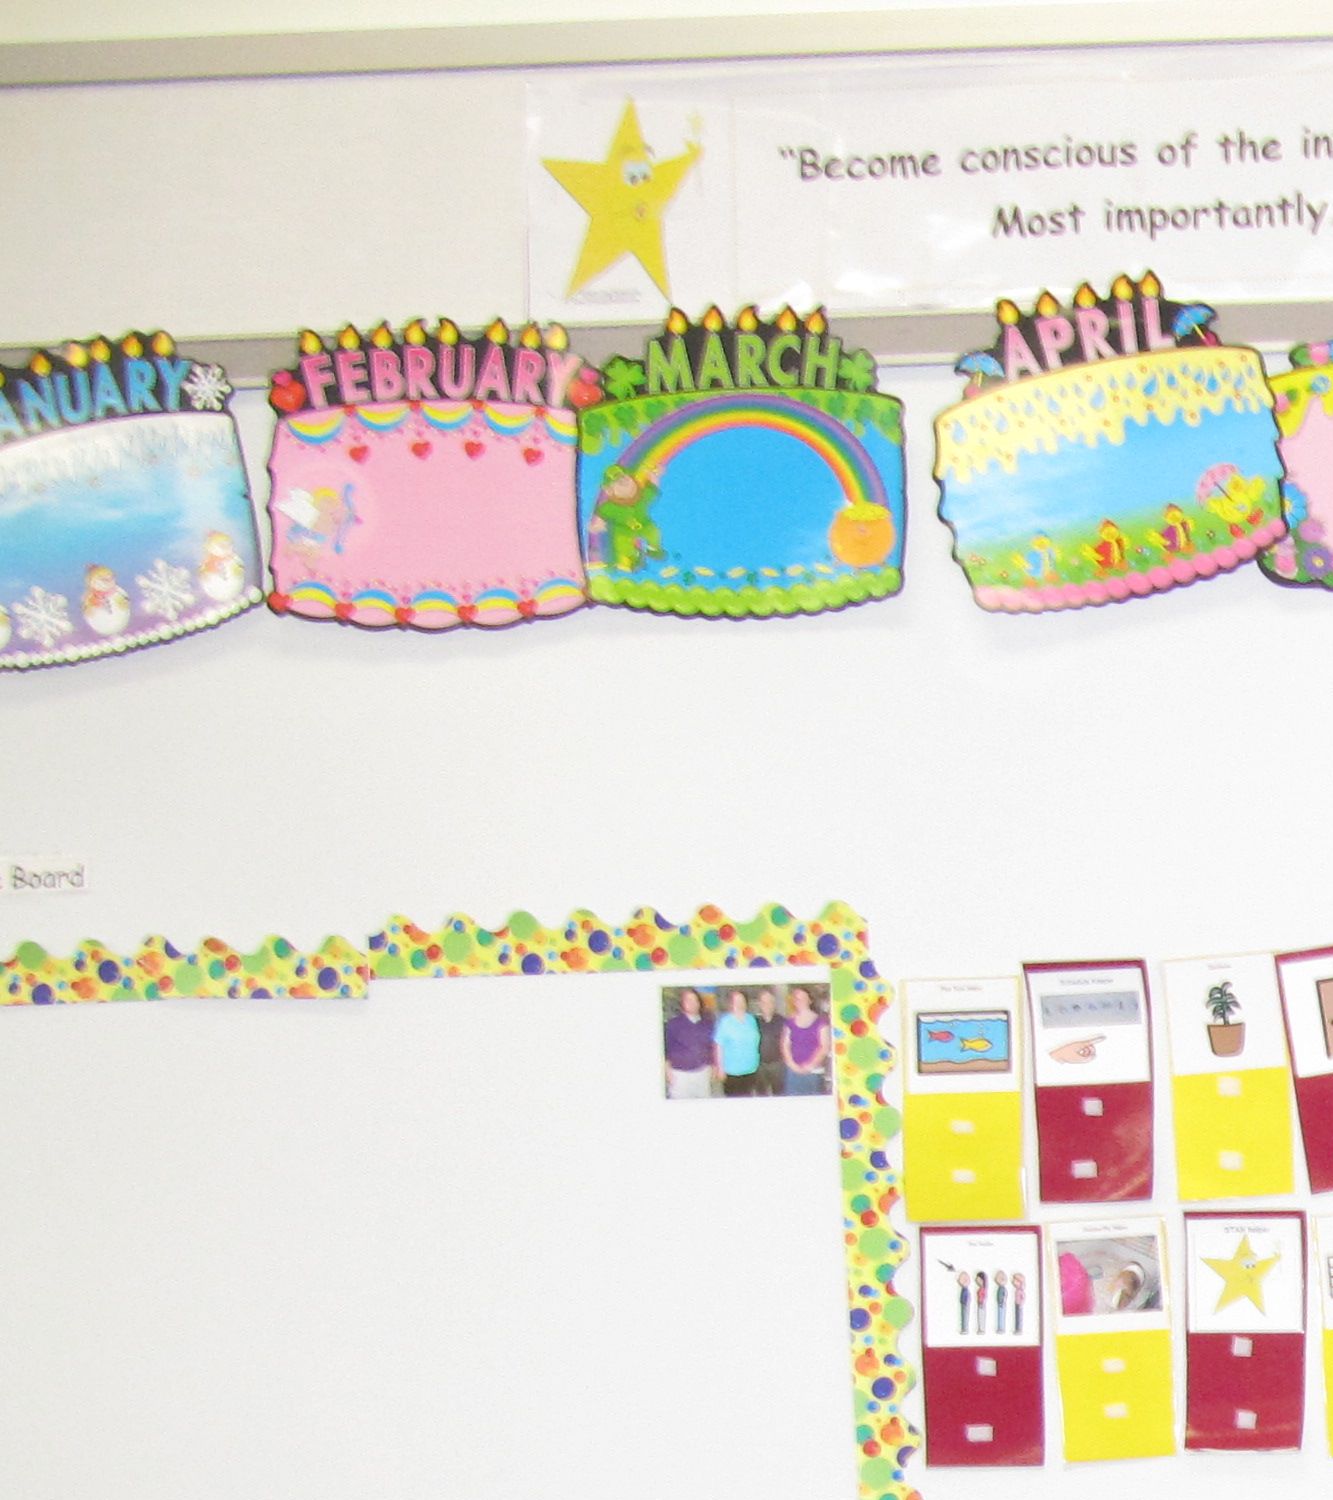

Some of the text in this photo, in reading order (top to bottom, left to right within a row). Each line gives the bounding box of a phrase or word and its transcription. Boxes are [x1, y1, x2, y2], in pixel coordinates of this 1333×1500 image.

[959, 135, 1137, 174] conscious
[1155, 130, 1197, 167] of
[1216, 128, 1282, 164] the
[991, 202, 1085, 238] Most
[644, 335, 838, 393] MARCH
[1004, 296, 1174, 380] APRIL
[299, 345, 577, 405] FEBRUARY
[11, 864, 85, 889] Board
